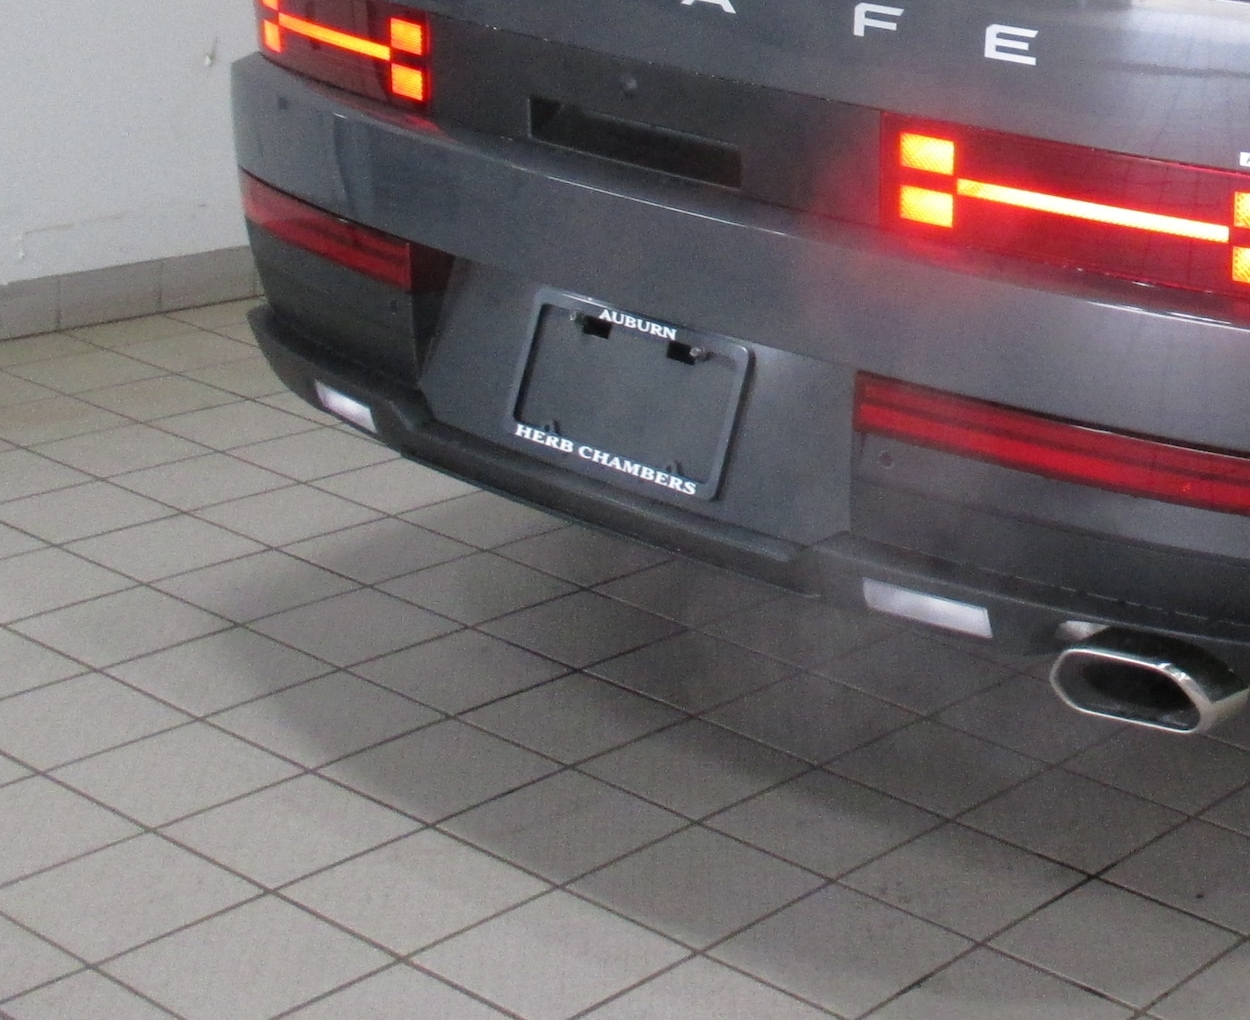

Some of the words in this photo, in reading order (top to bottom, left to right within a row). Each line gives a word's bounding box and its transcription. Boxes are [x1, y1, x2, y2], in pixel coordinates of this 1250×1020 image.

[853, 3, 1039, 65] FE
[599, 309, 677, 341] AUBURN
[514, 423, 574, 454] HERB
[578, 445, 697, 495] CHAMBERS
